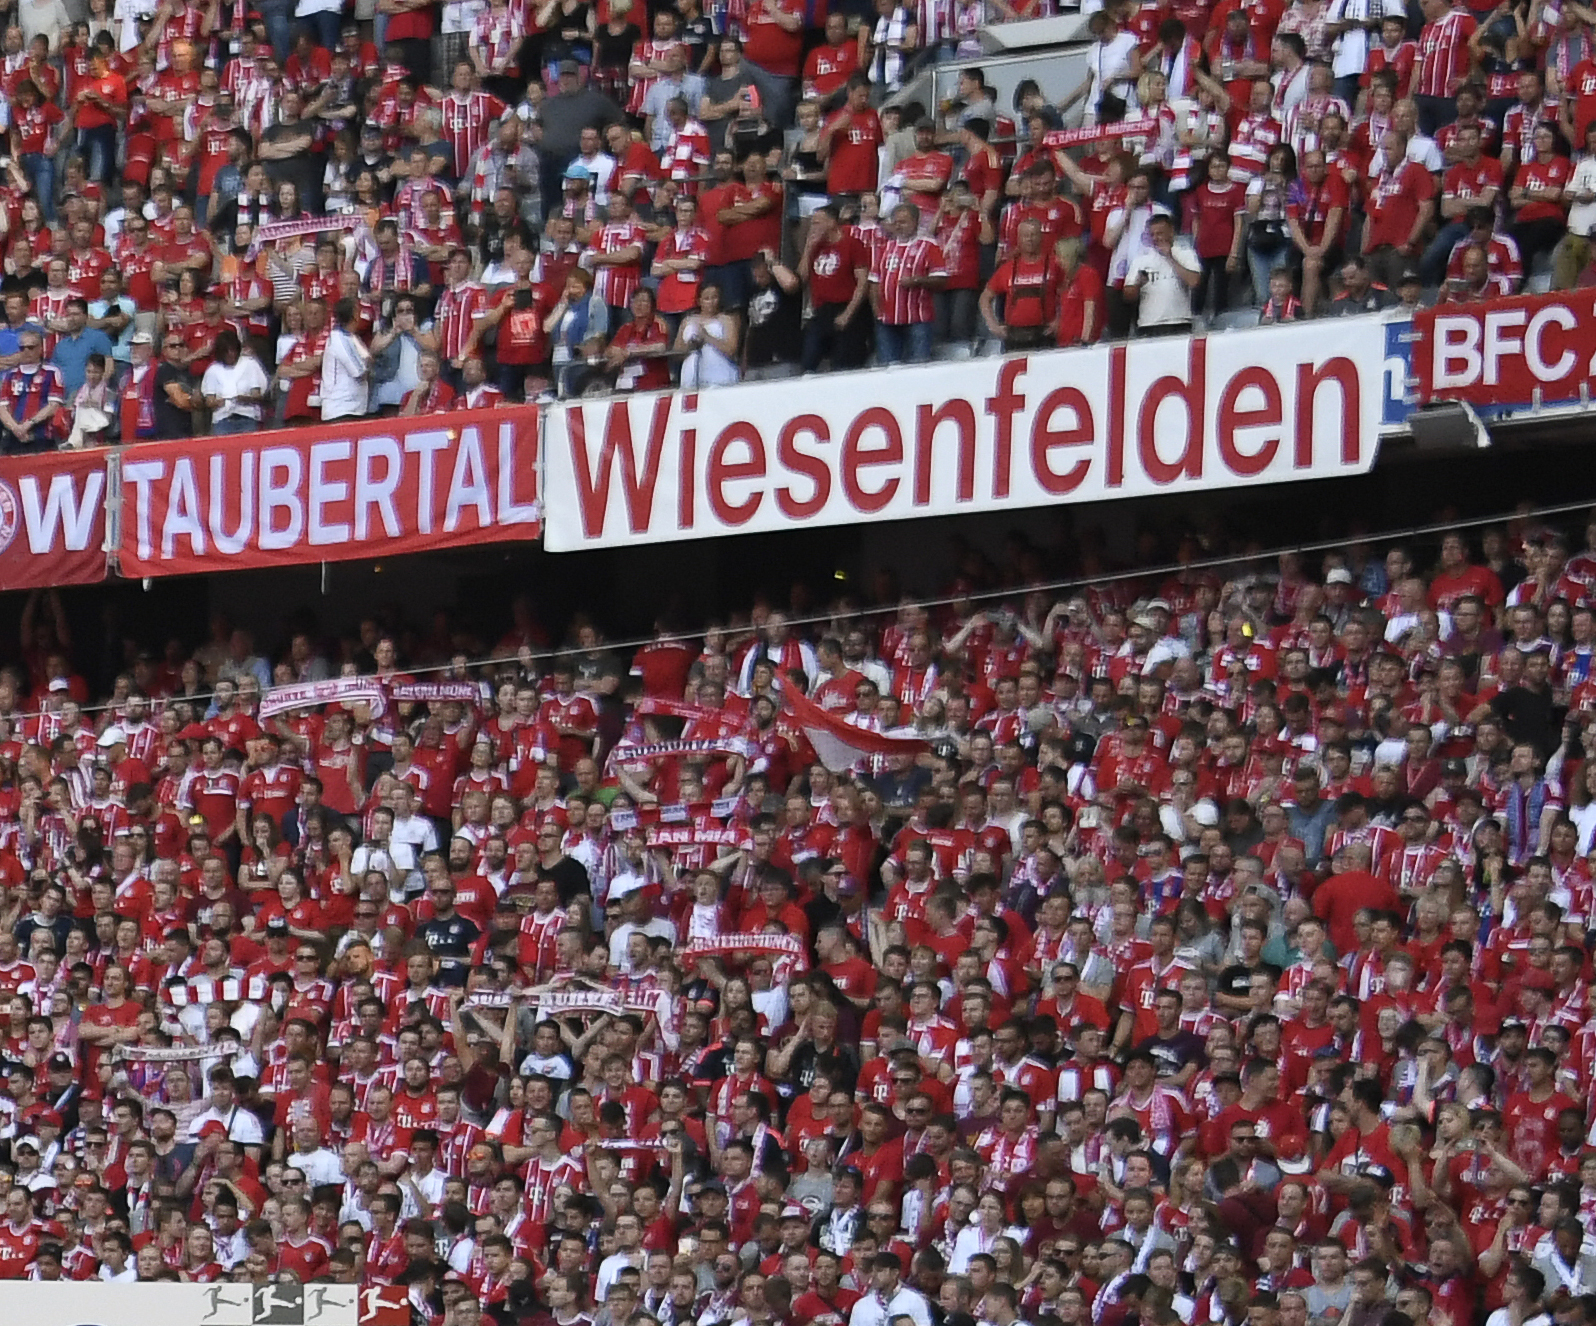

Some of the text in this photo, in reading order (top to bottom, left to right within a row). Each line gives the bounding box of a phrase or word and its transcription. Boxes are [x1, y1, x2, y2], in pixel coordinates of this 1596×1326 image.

[1432, 304, 1578, 391] BFC
[123, 421, 538, 562] TAUBERTAL
[567, 337, 1362, 541] Wiesenfelden
